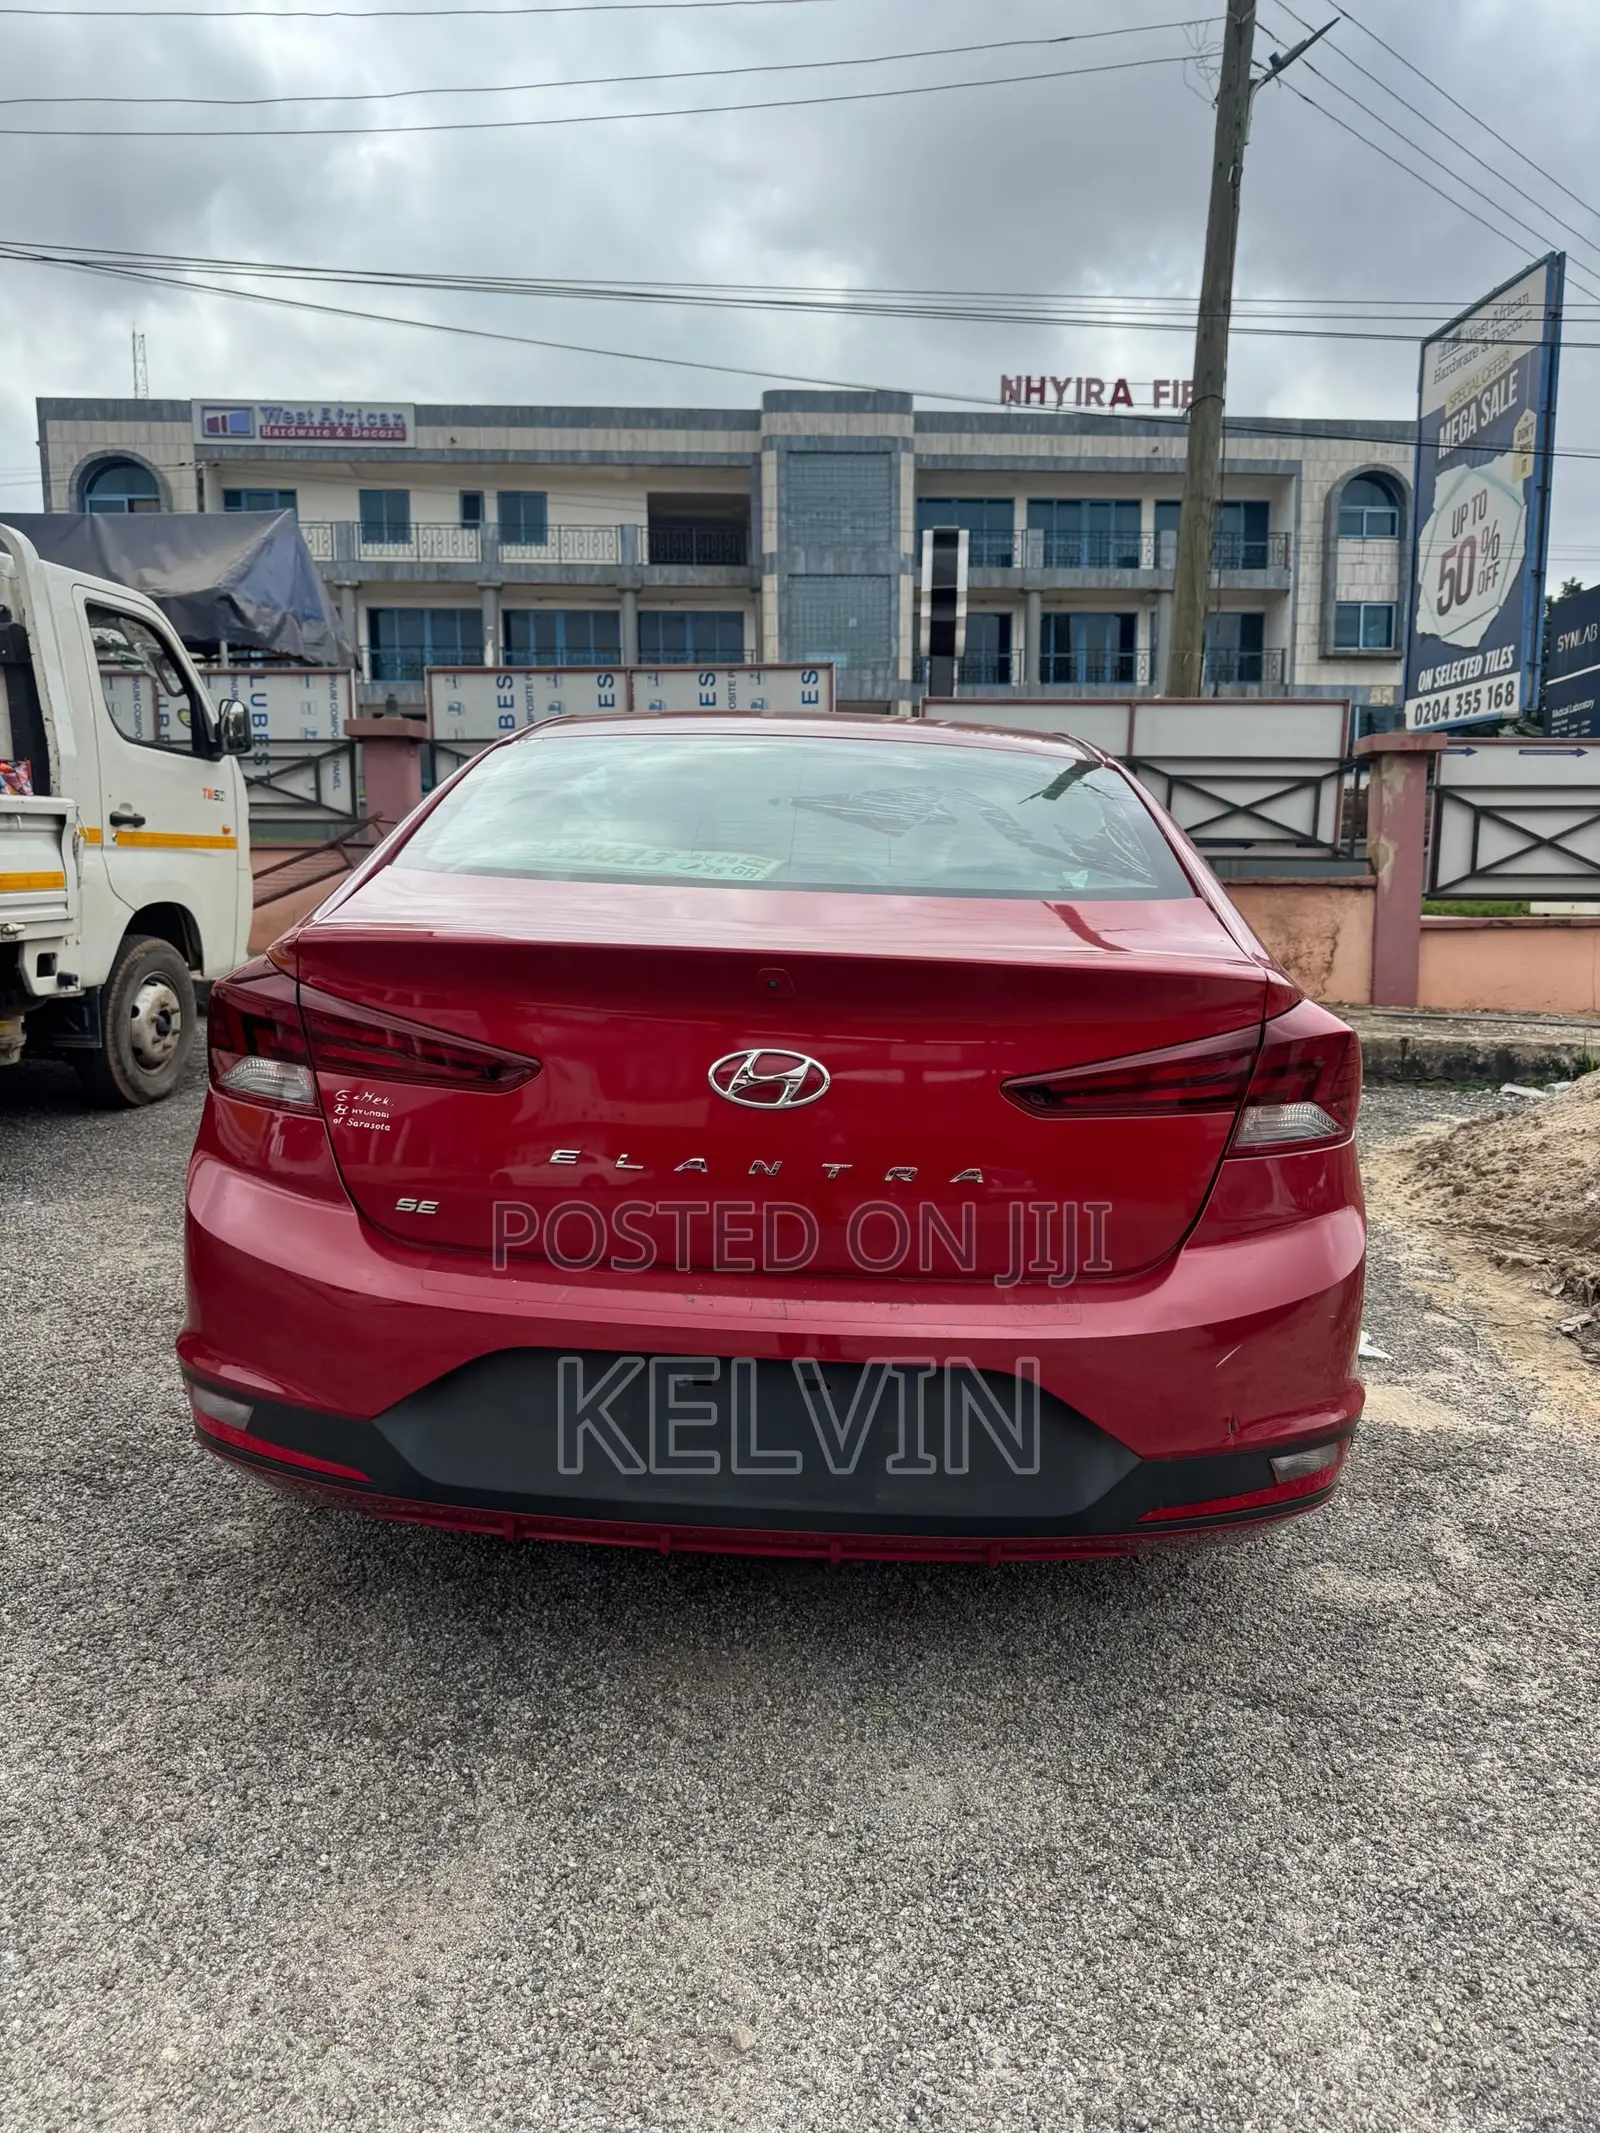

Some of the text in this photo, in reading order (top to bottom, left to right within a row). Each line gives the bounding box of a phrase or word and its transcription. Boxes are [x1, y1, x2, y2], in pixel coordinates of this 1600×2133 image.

[1465, 319, 1489, 343] West
[1490, 292, 1529, 327] African
[1433, 346, 1479, 385] Hardware
[1448, 350, 1510, 411] SPECIAL OFFER
[1001, 375, 1133, 408] NHYIRA
[260, 406, 405, 428] West African
[1438, 368, 1518, 459] MEGA SALE
[262, 426, 331, 438] Hardware
[336, 427, 345, 438] &
[1452, 489, 1488, 539] UP TO
[1477, 560, 1500, 596] OFF
[1557, 623, 1598, 652] SYNLAB
[1418, 644, 1515, 692] ON SELECTED TILES
[496, 674, 515, 729] BES
[598, 674, 615, 707] ES
[698, 672, 716, 706] ES
[802, 670, 819, 704] ES
[1415, 680, 1515, 726] 0204 355 168
[1551, 699, 1595, 719] Medical Laboratory
[333, 1116, 391, 1131] of Sarasota
[351, 1108, 390, 1119] HYUNDAI
[549, 1148, 985, 1184] ELANTRA
[394, 1197, 440, 1215] SE
